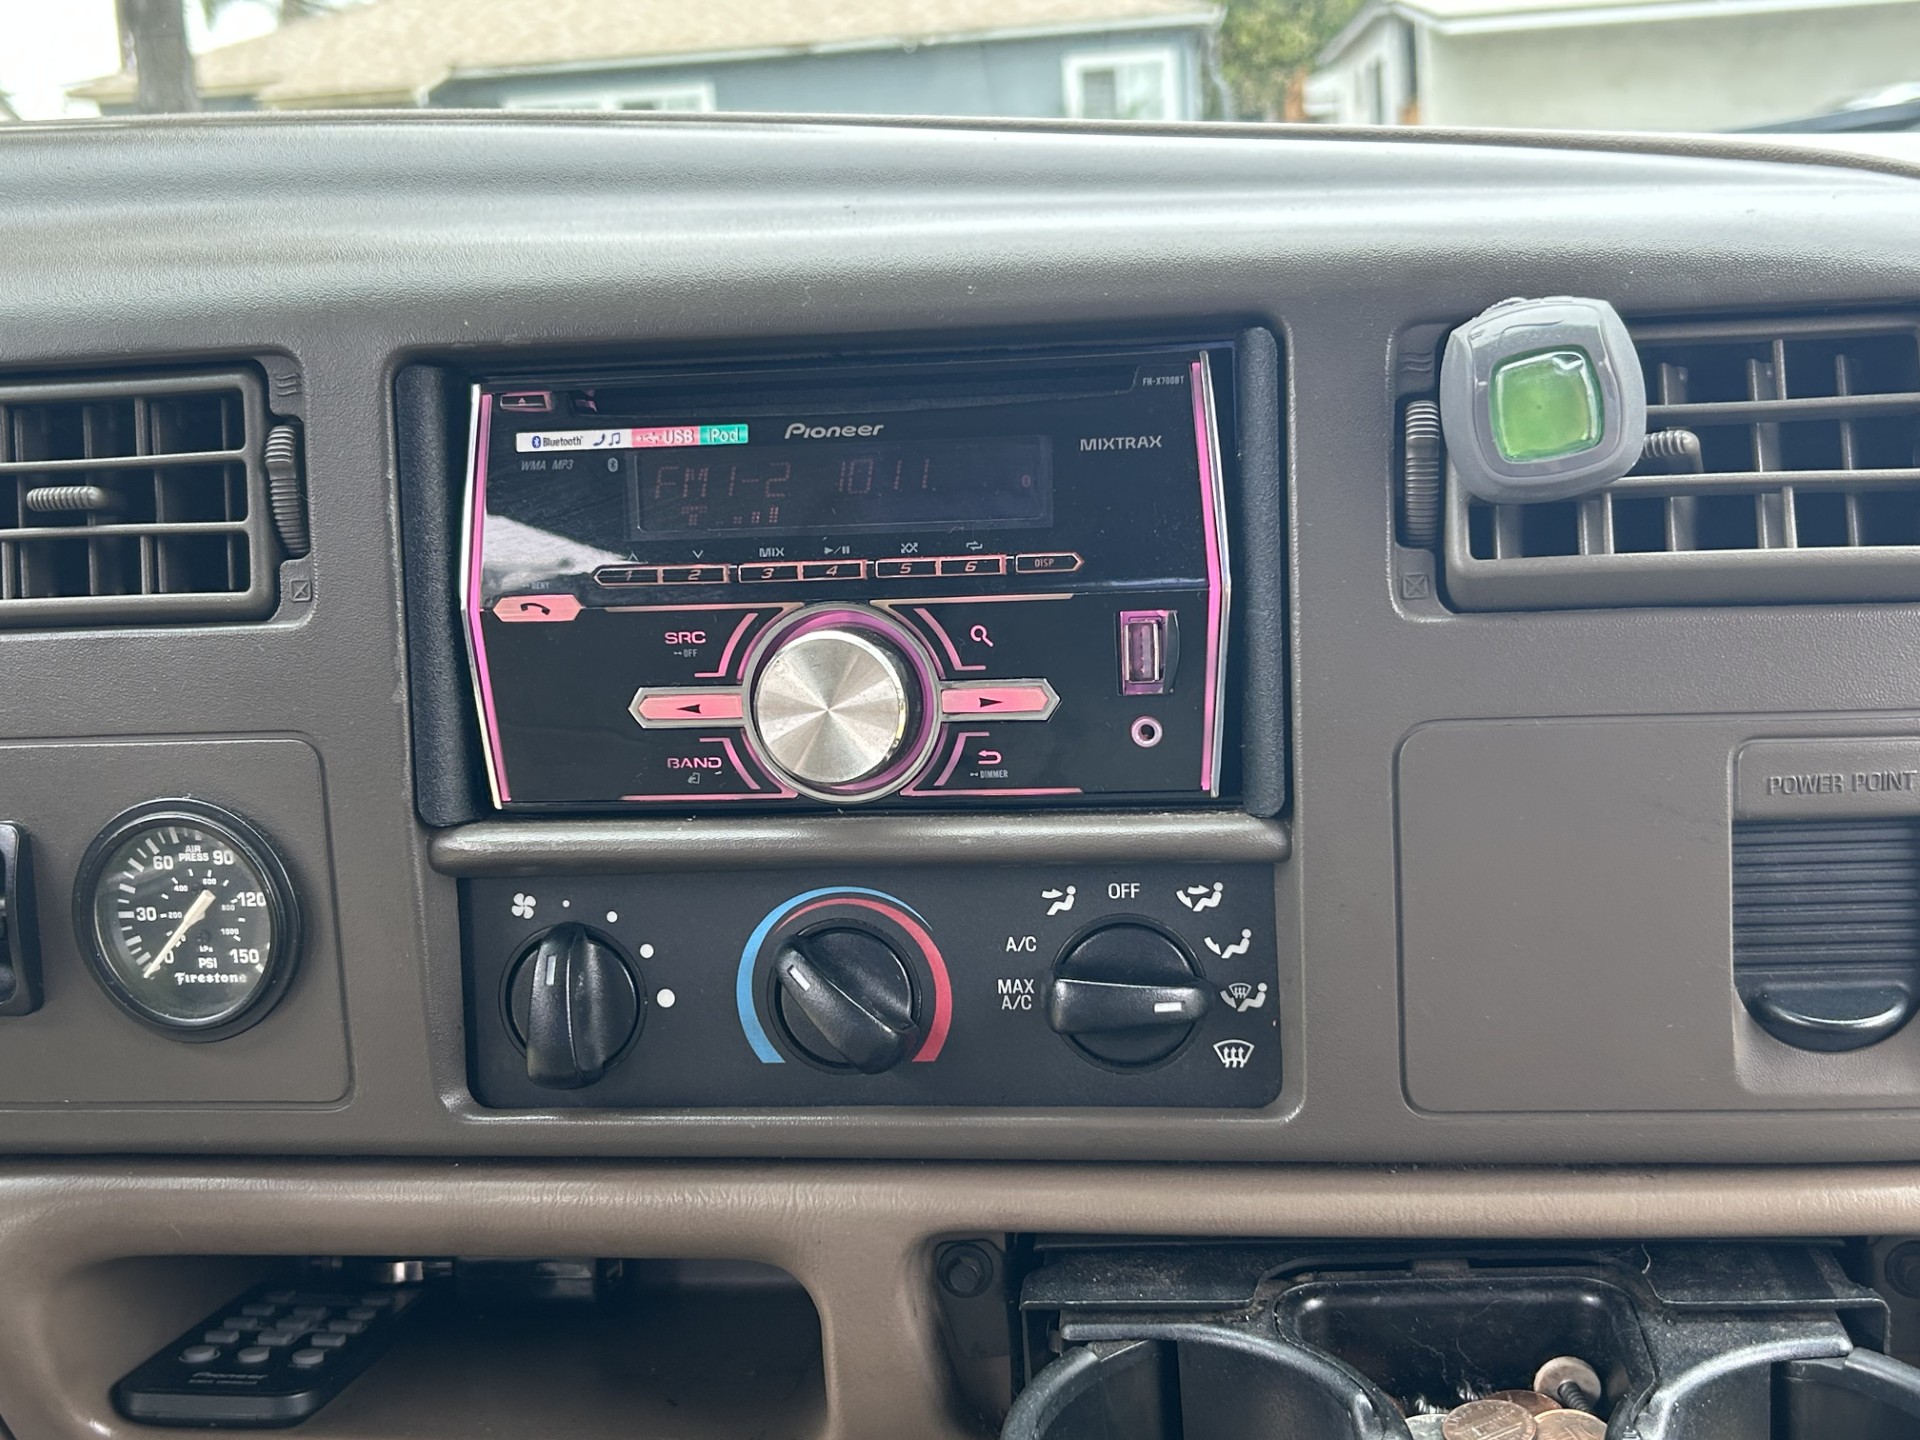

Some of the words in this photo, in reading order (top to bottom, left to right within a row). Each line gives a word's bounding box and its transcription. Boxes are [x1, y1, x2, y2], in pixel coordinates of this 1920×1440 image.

[662, 427, 695, 444] USB
[707, 427, 741, 443] iPod
[784, 422, 885, 440] Pioneer
[543, 436, 583, 448] Bluetooth
[1079, 435, 1163, 452] MIXTRAX
[521, 460, 546, 471] WMA
[552, 459, 574, 470] MP3
[759, 547, 785, 558] MIX
[900, 562, 912, 574] 5
[964, 560, 978, 572] 6
[1034, 558, 1055, 568] DISP
[687, 569, 701, 581] 2
[760, 568, 775, 579] 3
[825, 565, 838, 577] 4
[664, 631, 707, 644] SRC
[683, 649, 698, 658] OFF
[666, 757, 722, 769] BAND
[980, 769, 1009, 779] DIMMER
[1768, 773, 1845, 796] POWER
[1852, 770, 1918, 792] POINT
[185, 845, 202, 853] AIR
[152, 855, 174, 870] 60
[178, 852, 210, 863] PRESS
[212, 850, 234, 866] 90
[173, 884, 188, 893] 400
[1107, 882, 1141, 900] OFF
[236, 892, 267, 907] 120
[135, 906, 157, 921] 30
[168, 911, 183, 919] 200
[1005, 936, 1037, 953] A/C
[229, 949, 260, 964] 150
[198, 957, 218, 970] PSI
[174, 972, 248, 986] Firestone
[997, 978, 1035, 994] MAX
[1001, 994, 1033, 1010] A/C
